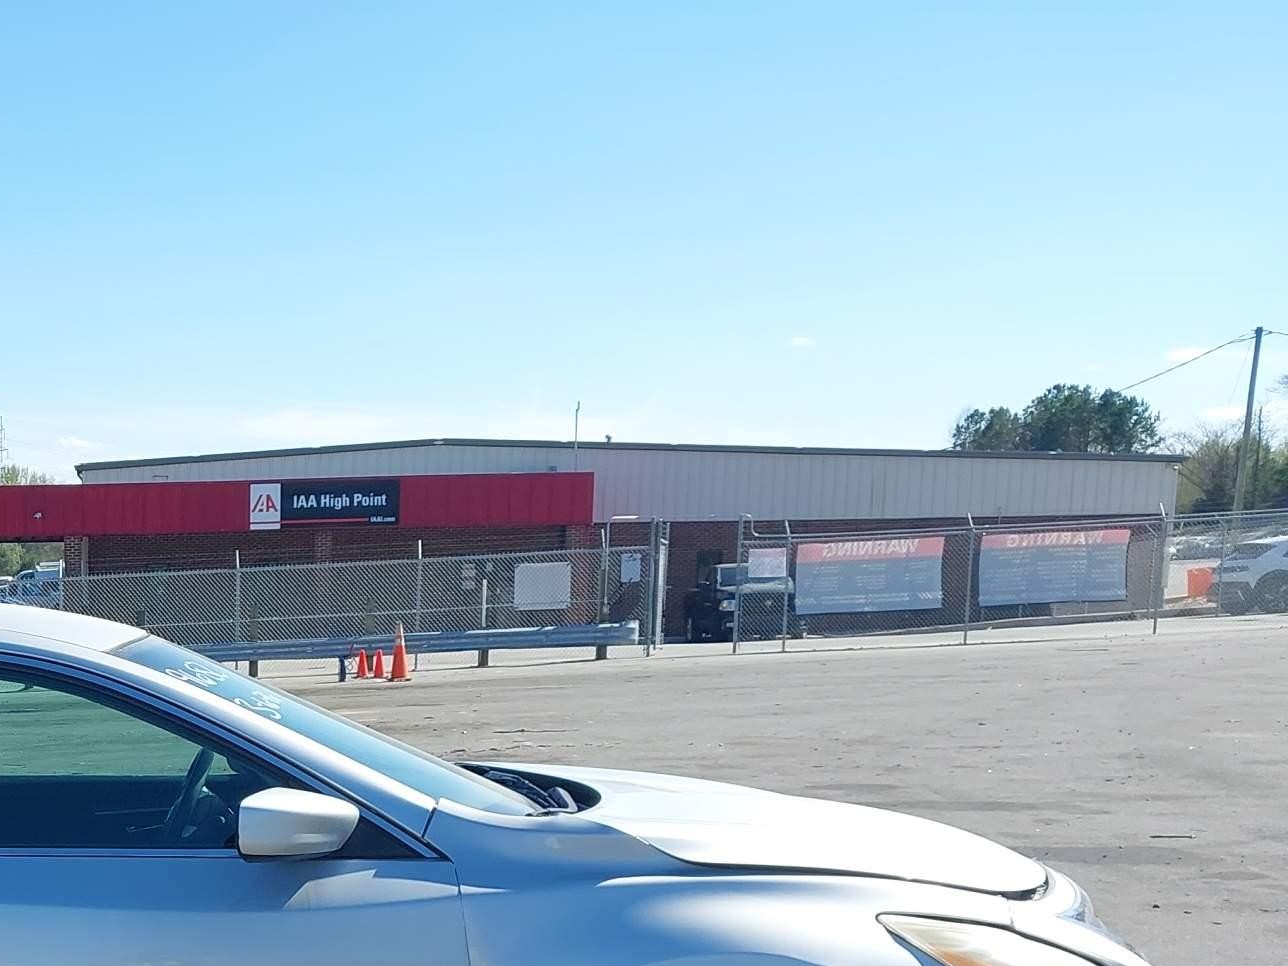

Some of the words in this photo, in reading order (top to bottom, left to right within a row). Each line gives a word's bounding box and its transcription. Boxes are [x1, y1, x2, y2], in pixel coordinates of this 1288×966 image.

[293, 494, 317, 509] IAA
[320, 493, 350, 510] High
[353, 492, 387, 507] Point
